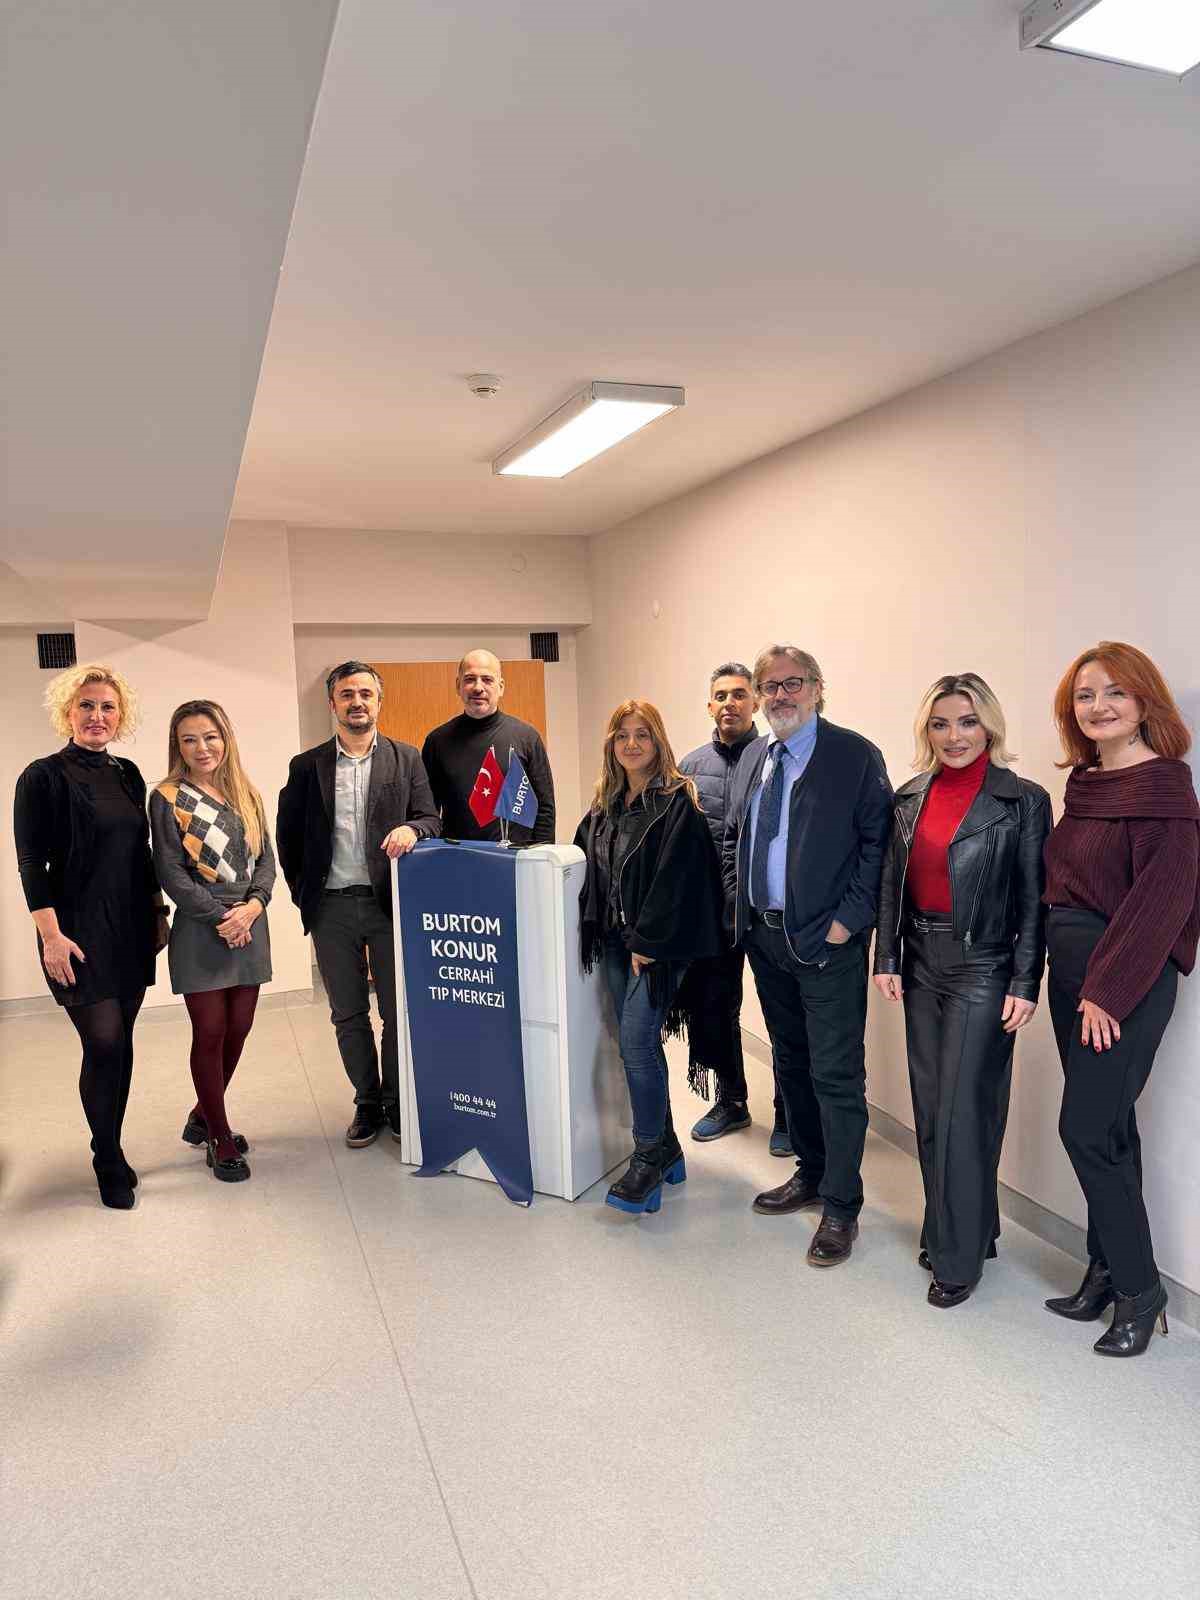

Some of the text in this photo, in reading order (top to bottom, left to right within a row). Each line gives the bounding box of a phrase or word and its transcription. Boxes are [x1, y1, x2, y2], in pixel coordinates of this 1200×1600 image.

[422, 913, 501, 937] BURTOM
[430, 939, 498, 963] KONUR
[438, 966, 494, 985] CERRAHİ
[428, 986, 505, 1009] TIP MERKEZİ
[485, 1098, 496, 1109] 44
